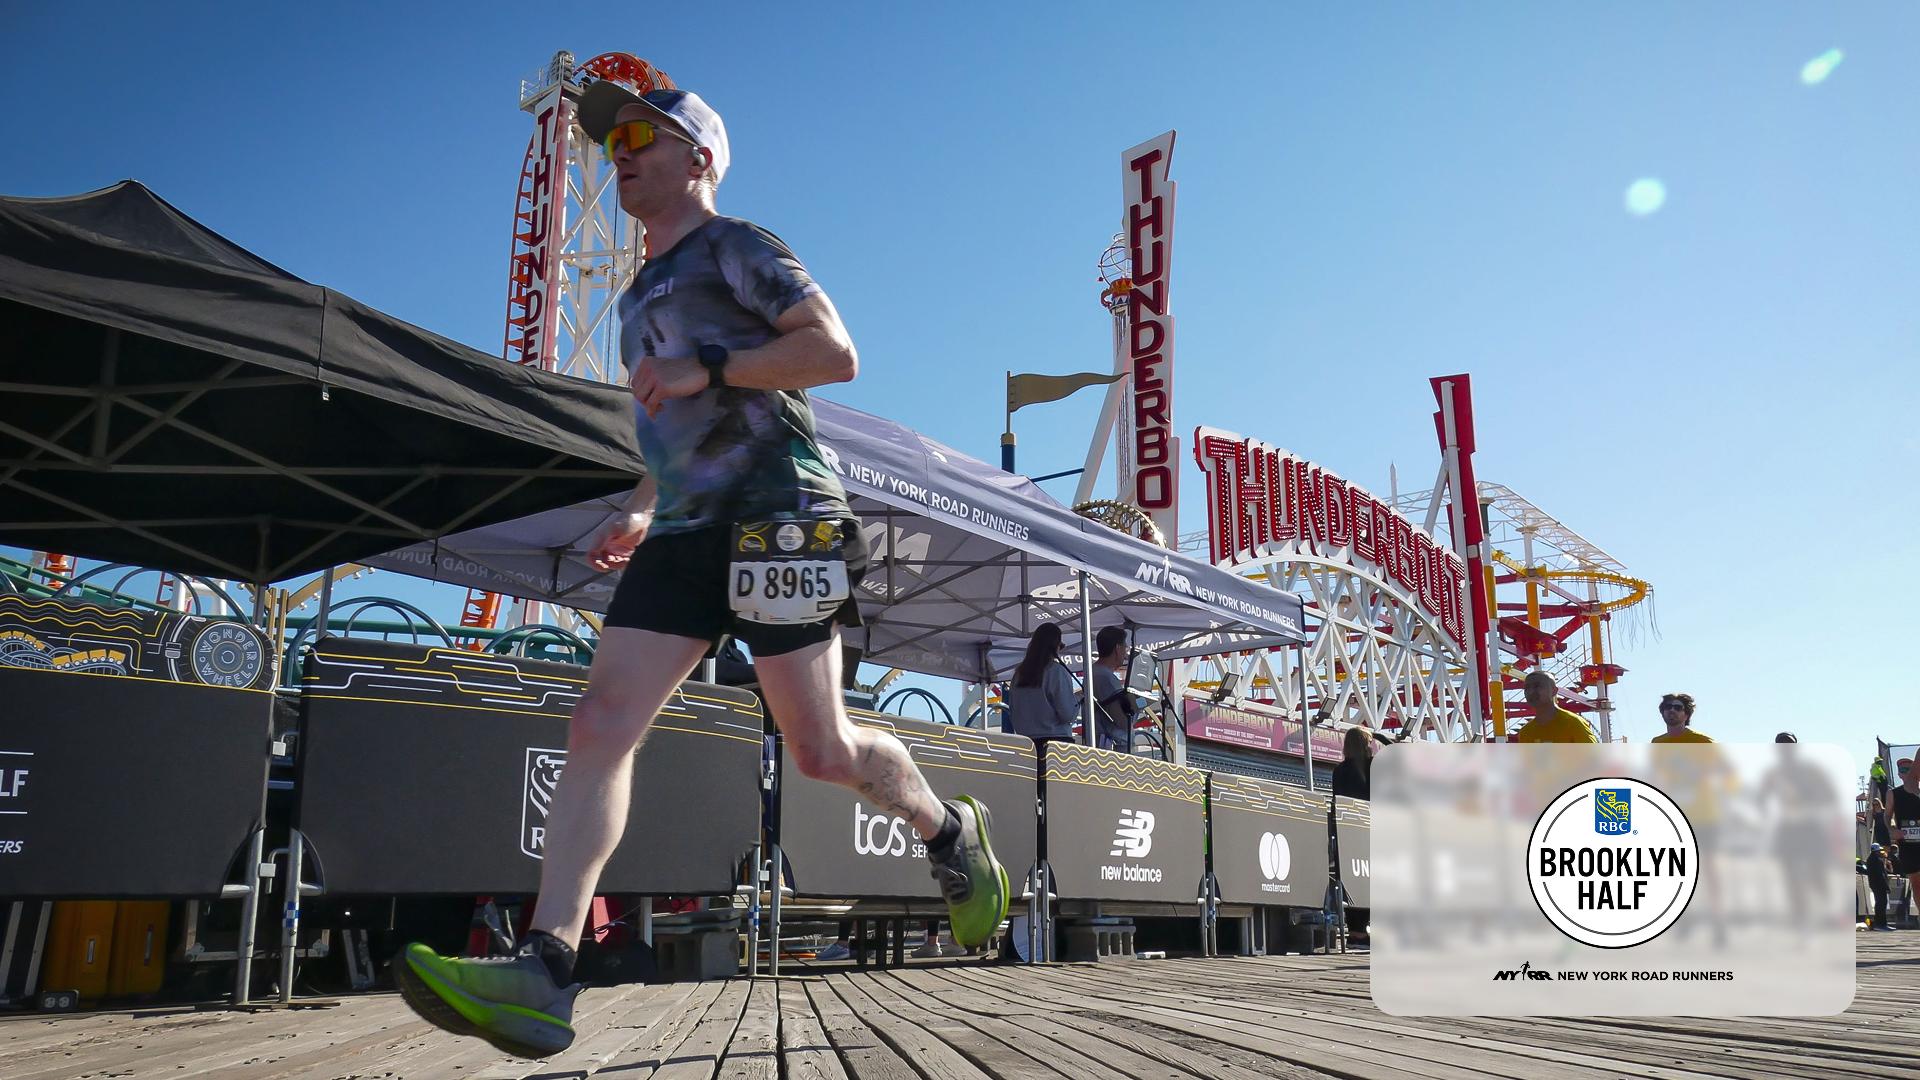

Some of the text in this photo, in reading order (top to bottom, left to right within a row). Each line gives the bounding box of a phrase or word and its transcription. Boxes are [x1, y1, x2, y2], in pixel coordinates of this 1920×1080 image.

[522, 106, 554, 367] THUNDE
[850, 462, 886, 488] NEW
[889, 476, 928, 504] YORK
[931, 492, 969, 518] ROAD
[971, 507, 1030, 541] RUNNERS
[1205, 434, 1467, 652] THUNDERBOLT
[737, 566, 831, 600] D 8965
[1195, 585, 1216, 603] NEW
[1217, 592, 1240, 611] YORK
[1240, 600, 1262, 618] ROAD
[1263, 608, 1296, 629] RUNNERS
[199, 628, 257, 661] WONDER
[201, 662, 252, 687] WHEEL
[1200, 703, 1275, 738] THUNDERBOLT
[1101, 862, 1162, 883] new balance
[1261, 882, 1291, 893] mastercard
